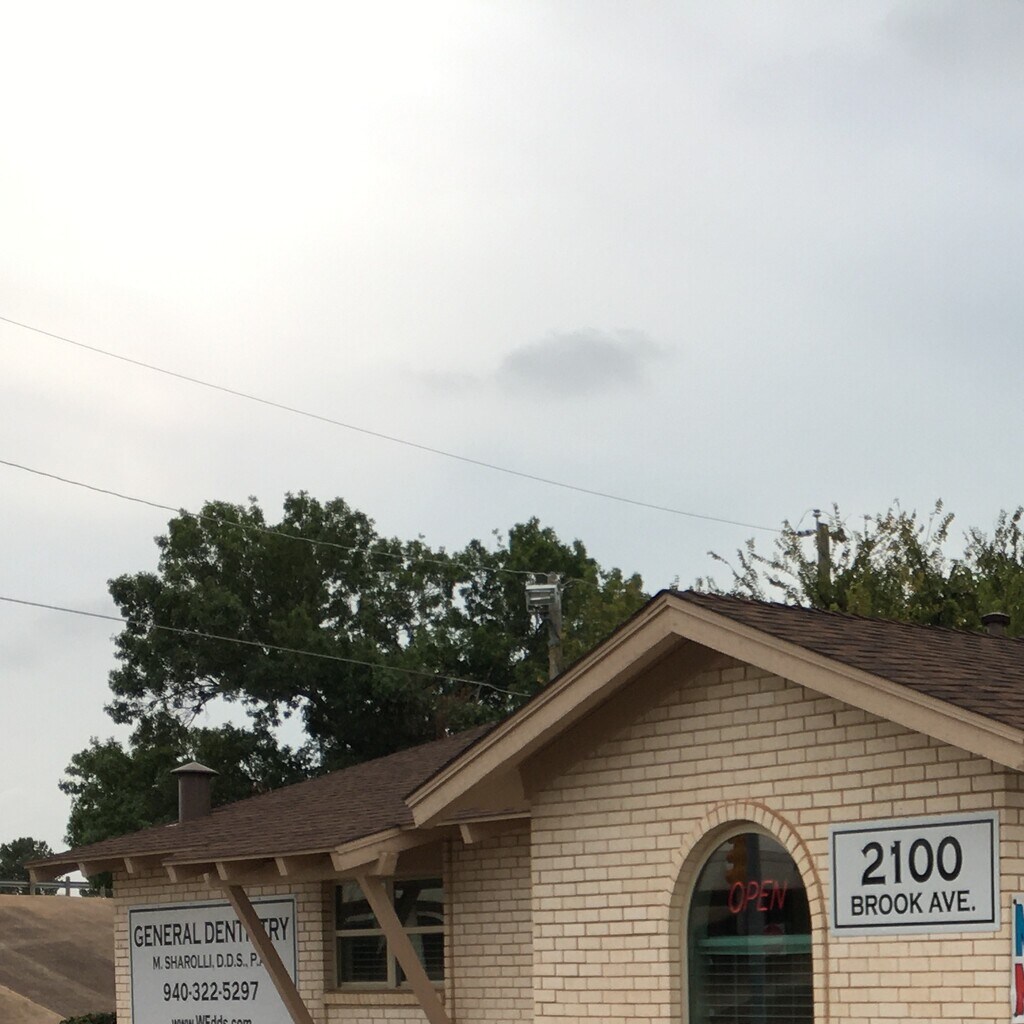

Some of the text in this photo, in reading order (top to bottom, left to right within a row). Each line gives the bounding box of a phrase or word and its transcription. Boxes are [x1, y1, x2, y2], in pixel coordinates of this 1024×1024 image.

[861, 836, 963, 886] 2100
[727, 879, 787, 913] OPEN
[851, 890, 976, 916] BROOK AVE.
[134, 917, 290, 948] GENERAL DENTTRY
[152, 956, 163, 970] M.
[163, 981, 259, 1001] 940-322-5297
